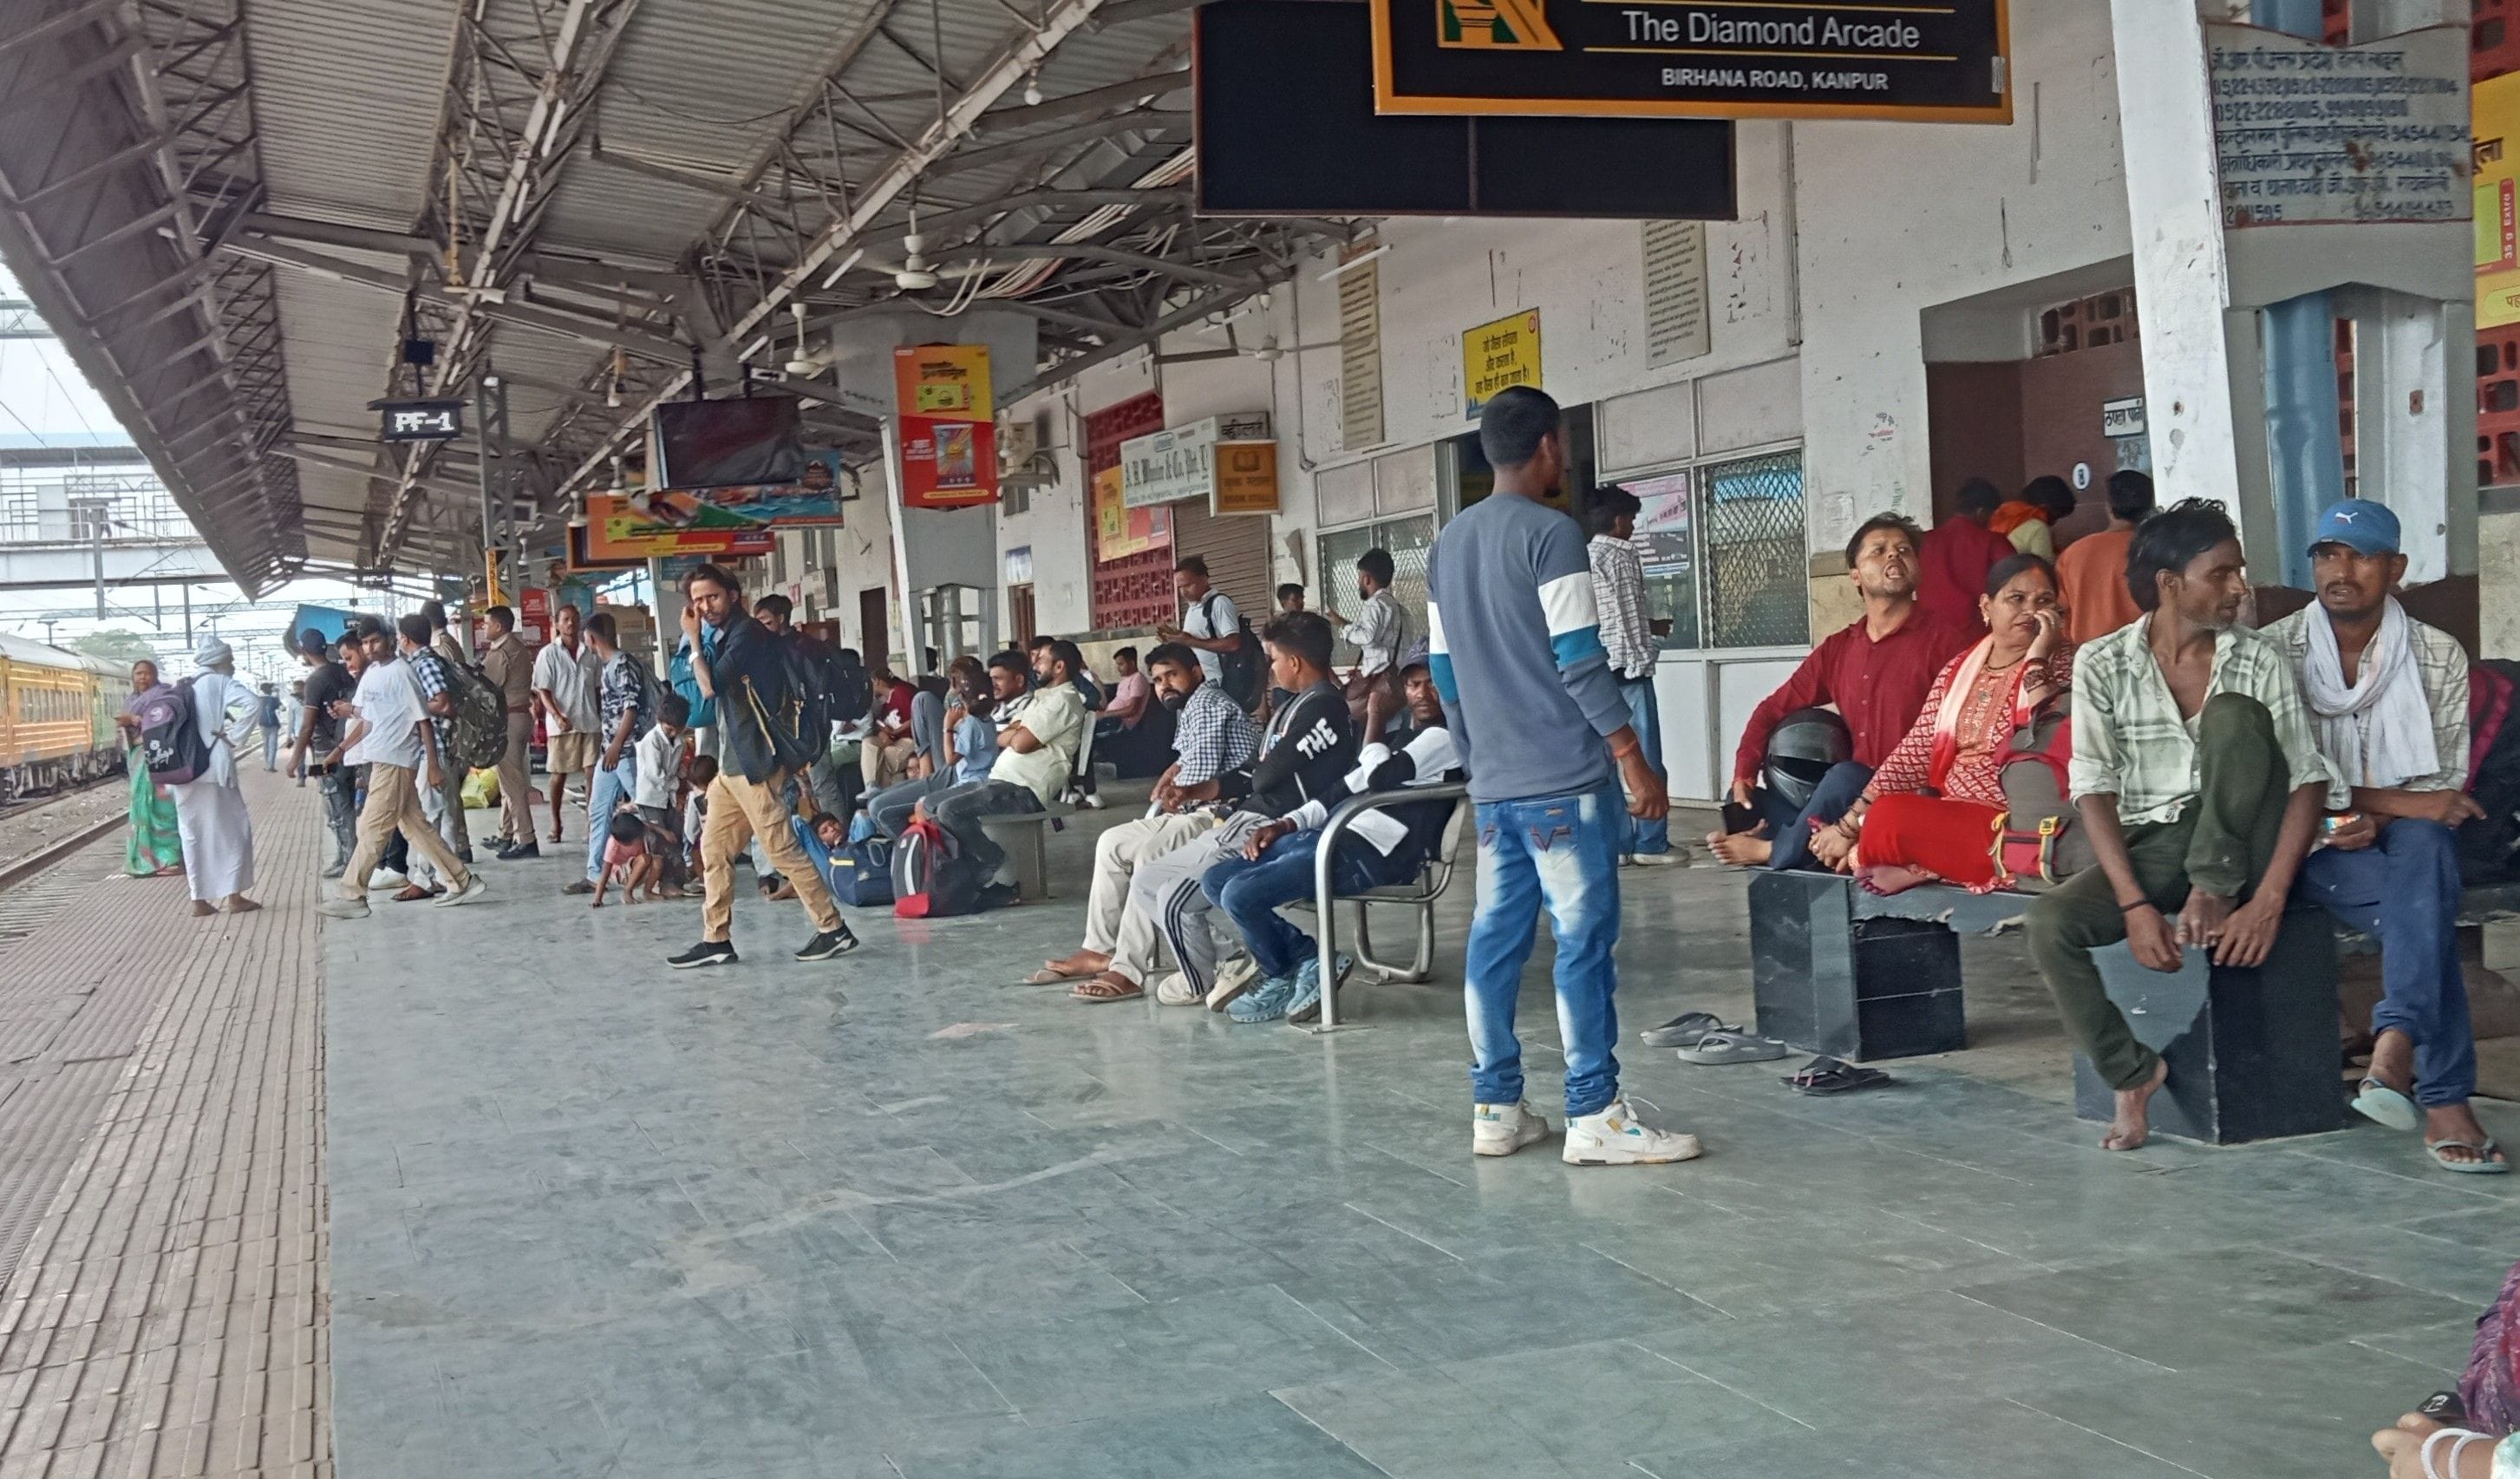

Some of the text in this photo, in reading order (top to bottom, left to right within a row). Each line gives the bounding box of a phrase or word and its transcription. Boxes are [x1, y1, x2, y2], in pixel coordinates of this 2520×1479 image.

[1622, 10, 1921, 49] The Diamond Arcade
[1662, 68, 1889, 91] BIRHANA ROAD, KANPUR
[2504, 193, 2512, 226] Extra
[395, 411, 455, 432] PF-1
[1296, 717, 1338, 760] THE
